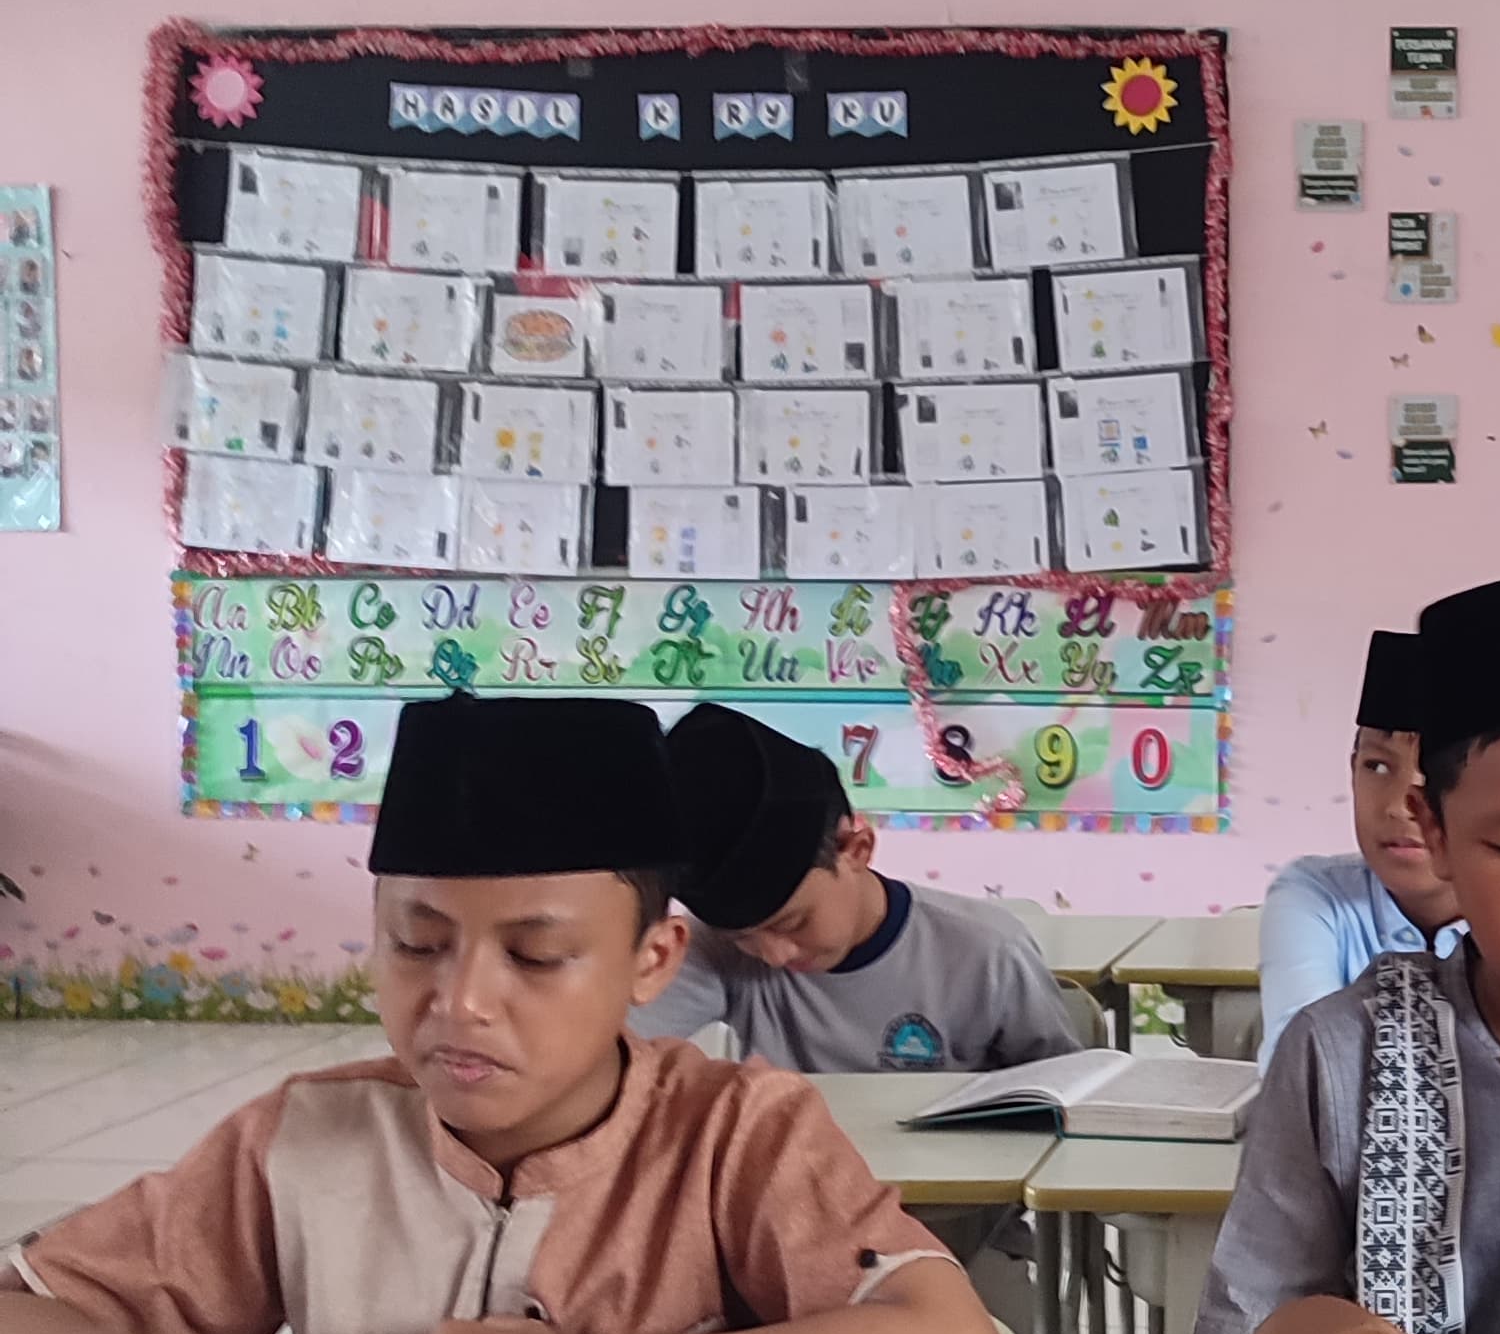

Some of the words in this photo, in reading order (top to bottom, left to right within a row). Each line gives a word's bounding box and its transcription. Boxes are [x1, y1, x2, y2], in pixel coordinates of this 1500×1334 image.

[401, 93, 569, 128] HASIL
[193, 585, 248, 630] Aa
[266, 583, 324, 631] Bb
[350, 582, 397, 630] Cc
[422, 583, 480, 630] Dd
[509, 584, 551, 630] Ee
[578, 585, 625, 639] Ff
[740, 585, 800, 633] Hh
[974, 591, 1040, 638] Kk
[193, 633, 249, 680] Nn
[270, 635, 322, 680] Oo
[349, 635, 404, 686] Pp
[500, 636, 559, 681] Rr
[577, 636, 626, 685] Ss
[739, 637, 800, 682] Uu
[980, 641, 1041, 684] Xx
[1060, 641, 1118, 695] Yy
[1139, 645, 1203, 694] Zz
[238, 718, 266, 782] 1
[328, 718, 365, 780] 2
[842, 723, 879, 786] 7
[934, 724, 975, 786] 8
[1035, 724, 1079, 789] 9
[1132, 727, 1174, 790] 0
